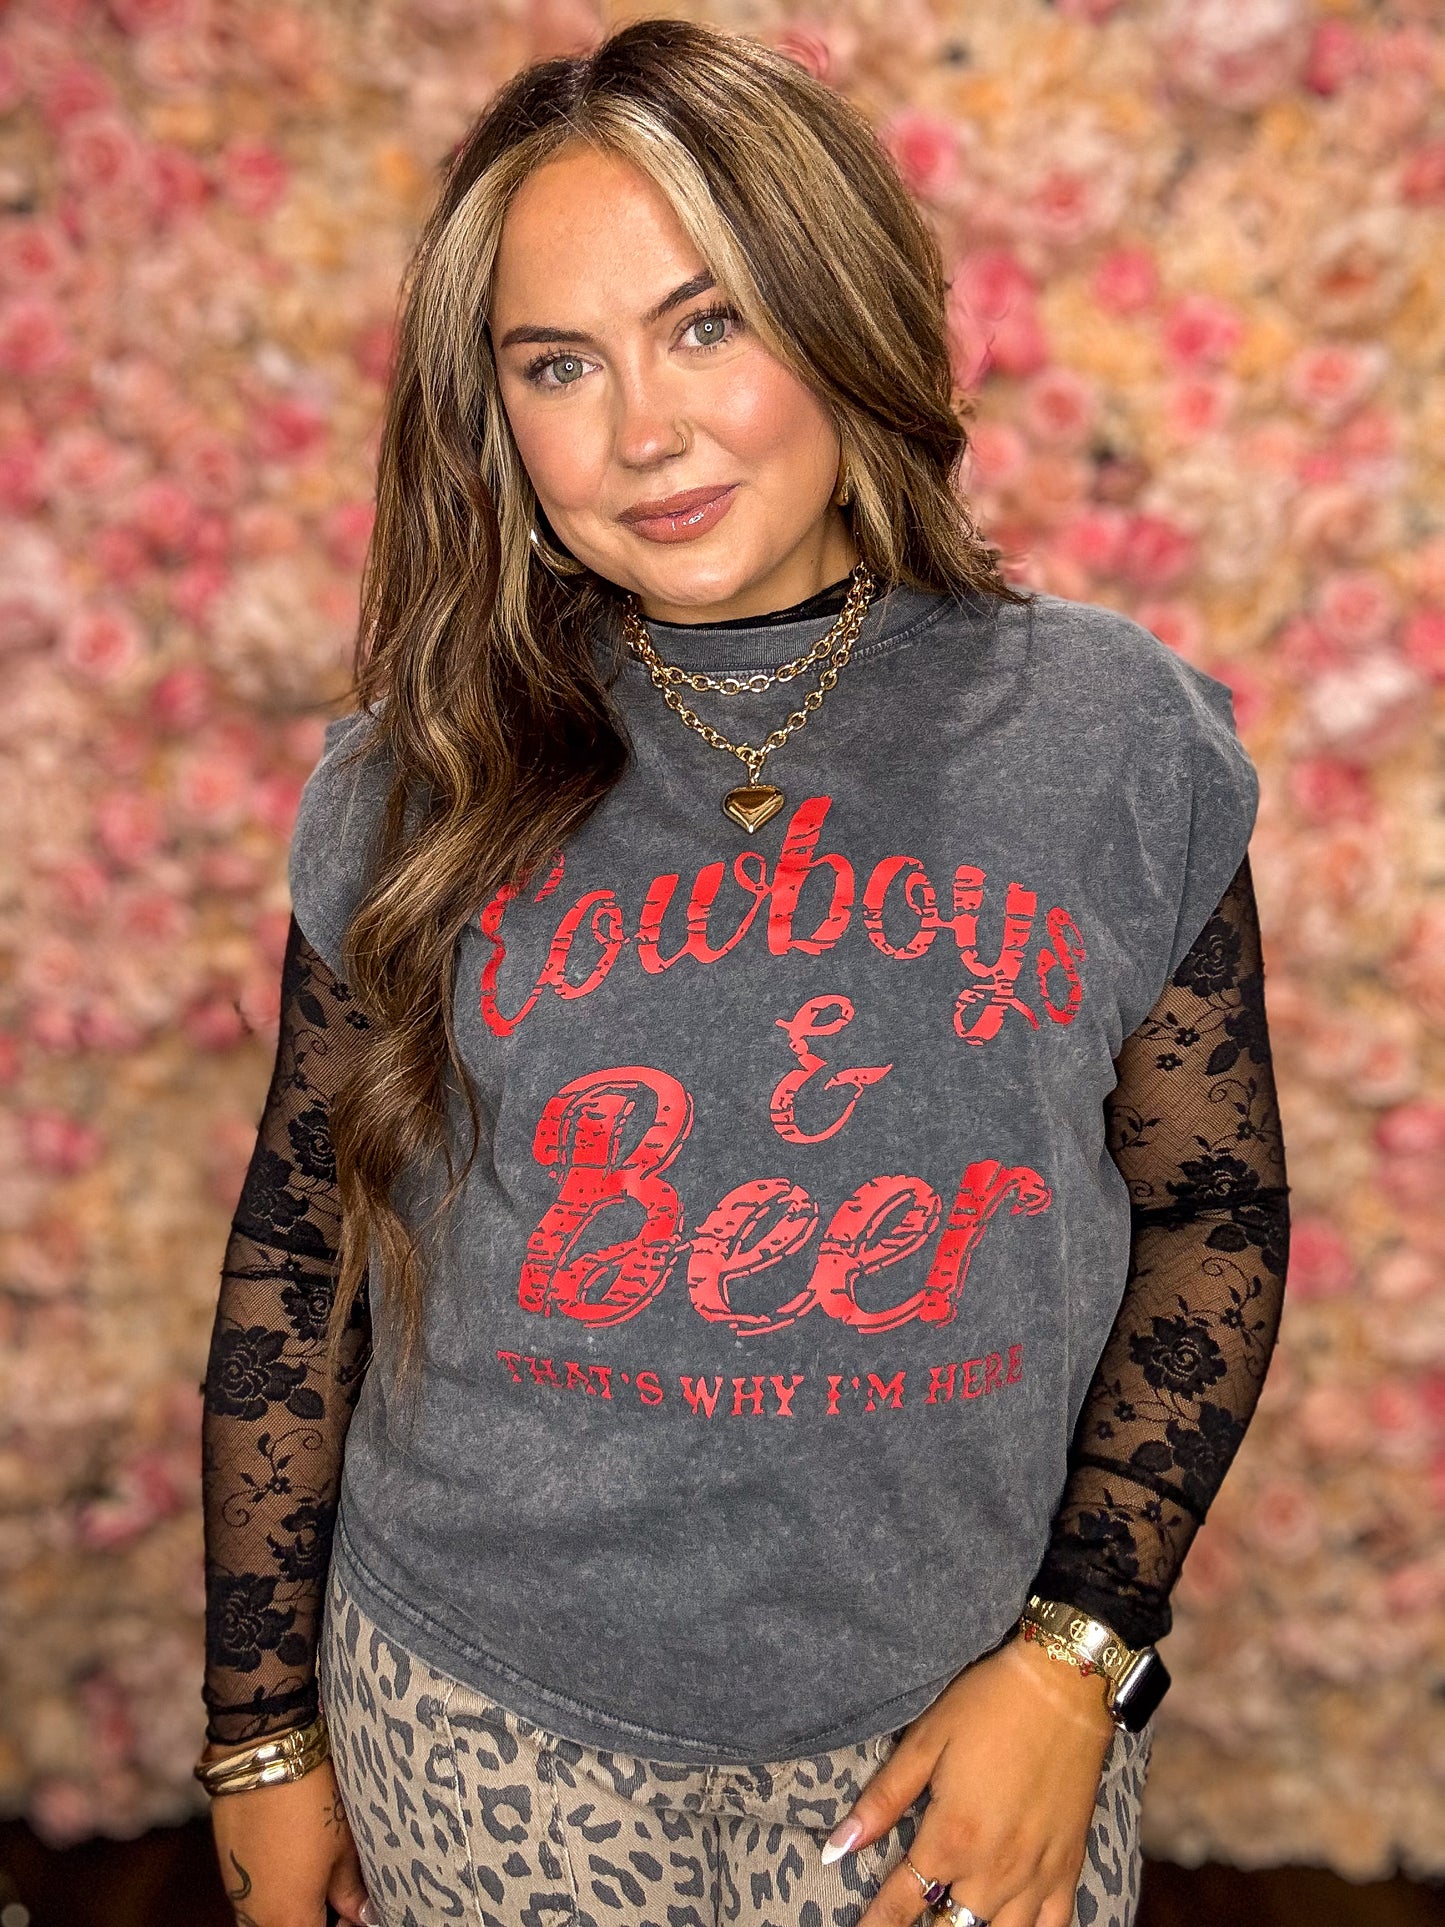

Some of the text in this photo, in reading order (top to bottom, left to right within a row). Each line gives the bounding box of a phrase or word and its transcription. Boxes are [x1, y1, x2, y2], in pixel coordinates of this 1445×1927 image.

[480, 795, 1086, 1046] Cowboys
[769, 994, 893, 1145] &
[517, 1065, 1053, 1337] Beer
[496, 1343, 1024, 1419] THAT'S WHY I'M HERE
